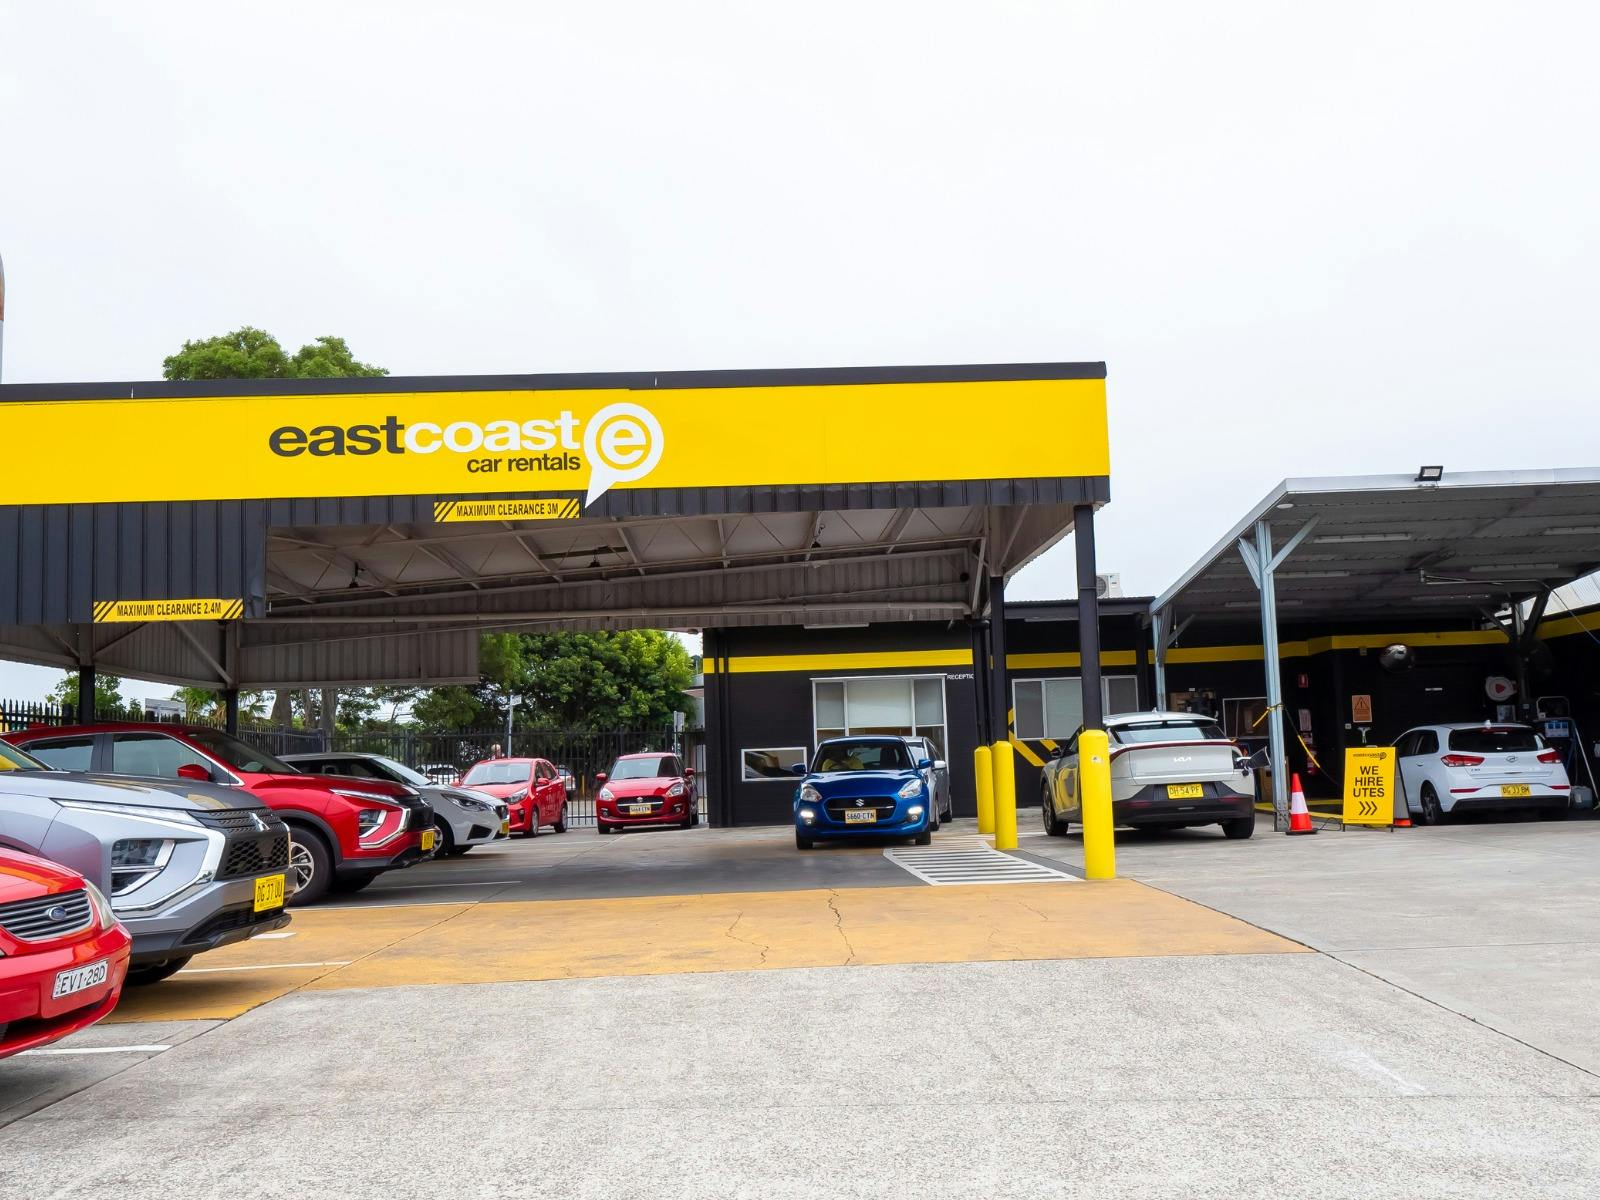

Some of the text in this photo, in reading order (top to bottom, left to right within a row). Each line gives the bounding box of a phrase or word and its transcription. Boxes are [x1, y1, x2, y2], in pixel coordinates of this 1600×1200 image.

[269, 411, 580, 457] eastcoast
[466, 452, 581, 473] car rentals
[456, 502, 559, 517] MAXIMUM CLEARANCE 3M
[117, 602, 222, 616] MAXIMUM CLEARANCE 2.4M
[1360, 765, 1379, 775] WE
[1354, 776, 1384, 787] HIRE
[1353, 787, 1385, 798] UTES
